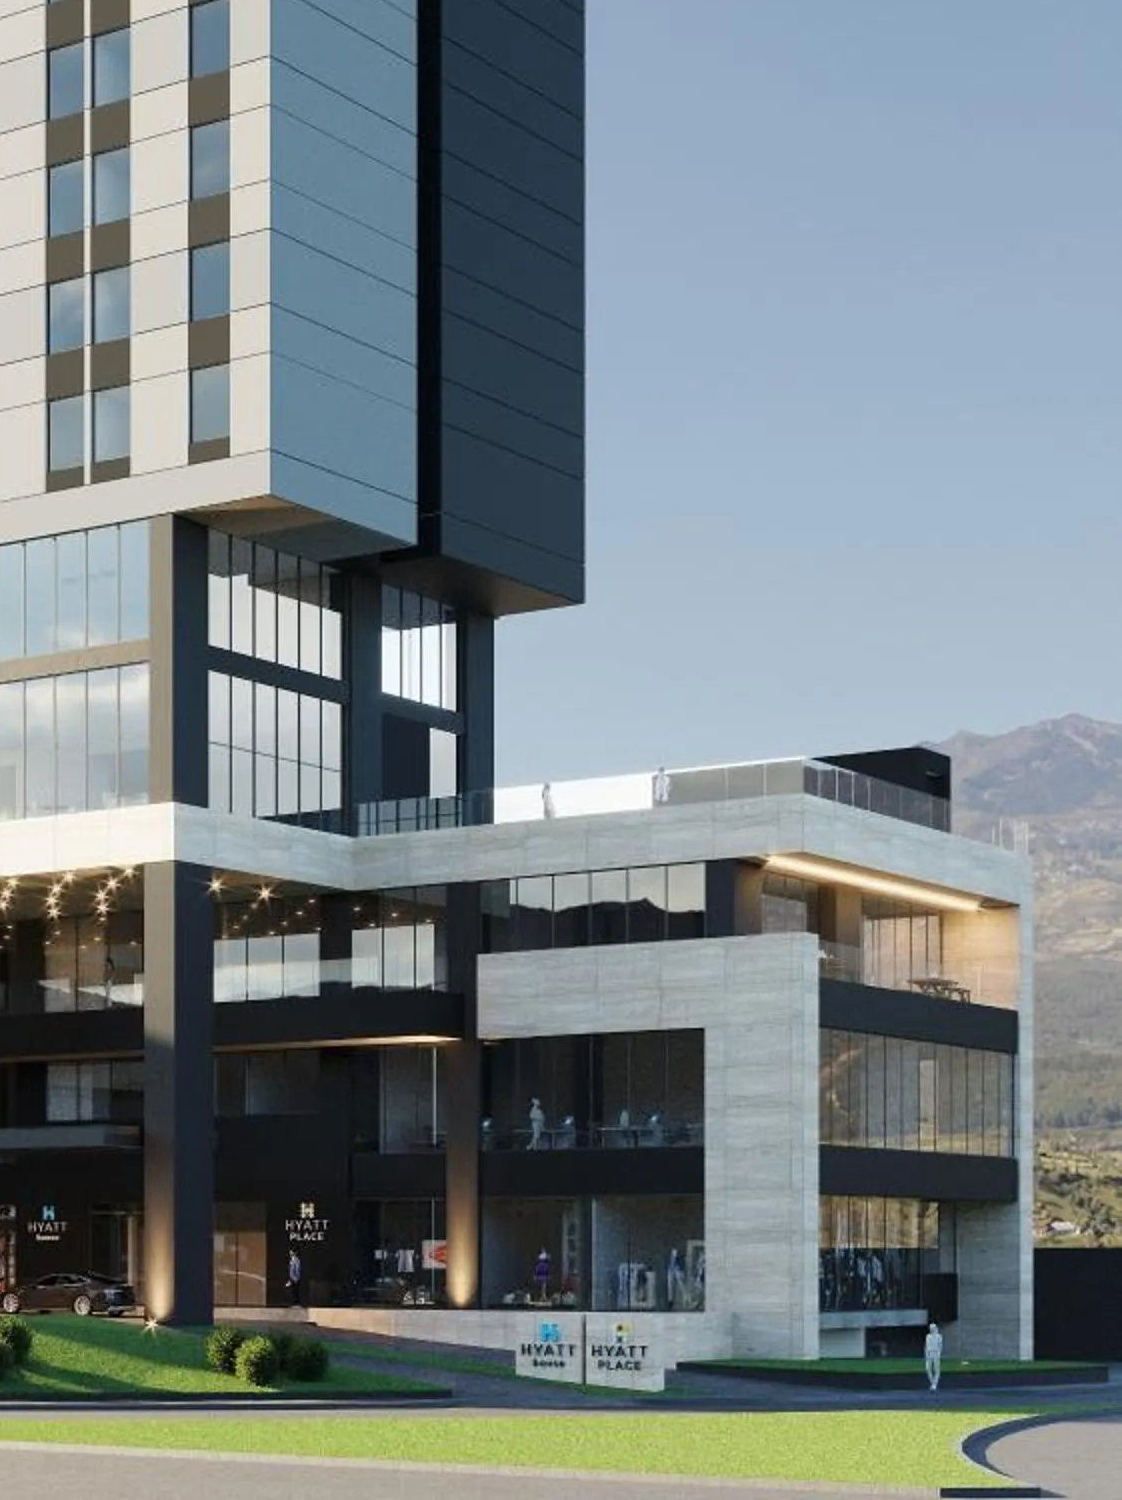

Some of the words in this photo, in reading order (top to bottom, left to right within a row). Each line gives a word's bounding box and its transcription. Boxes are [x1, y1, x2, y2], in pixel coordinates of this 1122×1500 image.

[27, 1221, 68, 1233] HYATT
[285, 1219, 329, 1231] HYATT
[289, 1231, 325, 1241] PLACE
[521, 1343, 576, 1357] HYATT
[591, 1345, 648, 1358] HYATT
[597, 1359, 642, 1371] PLACE
